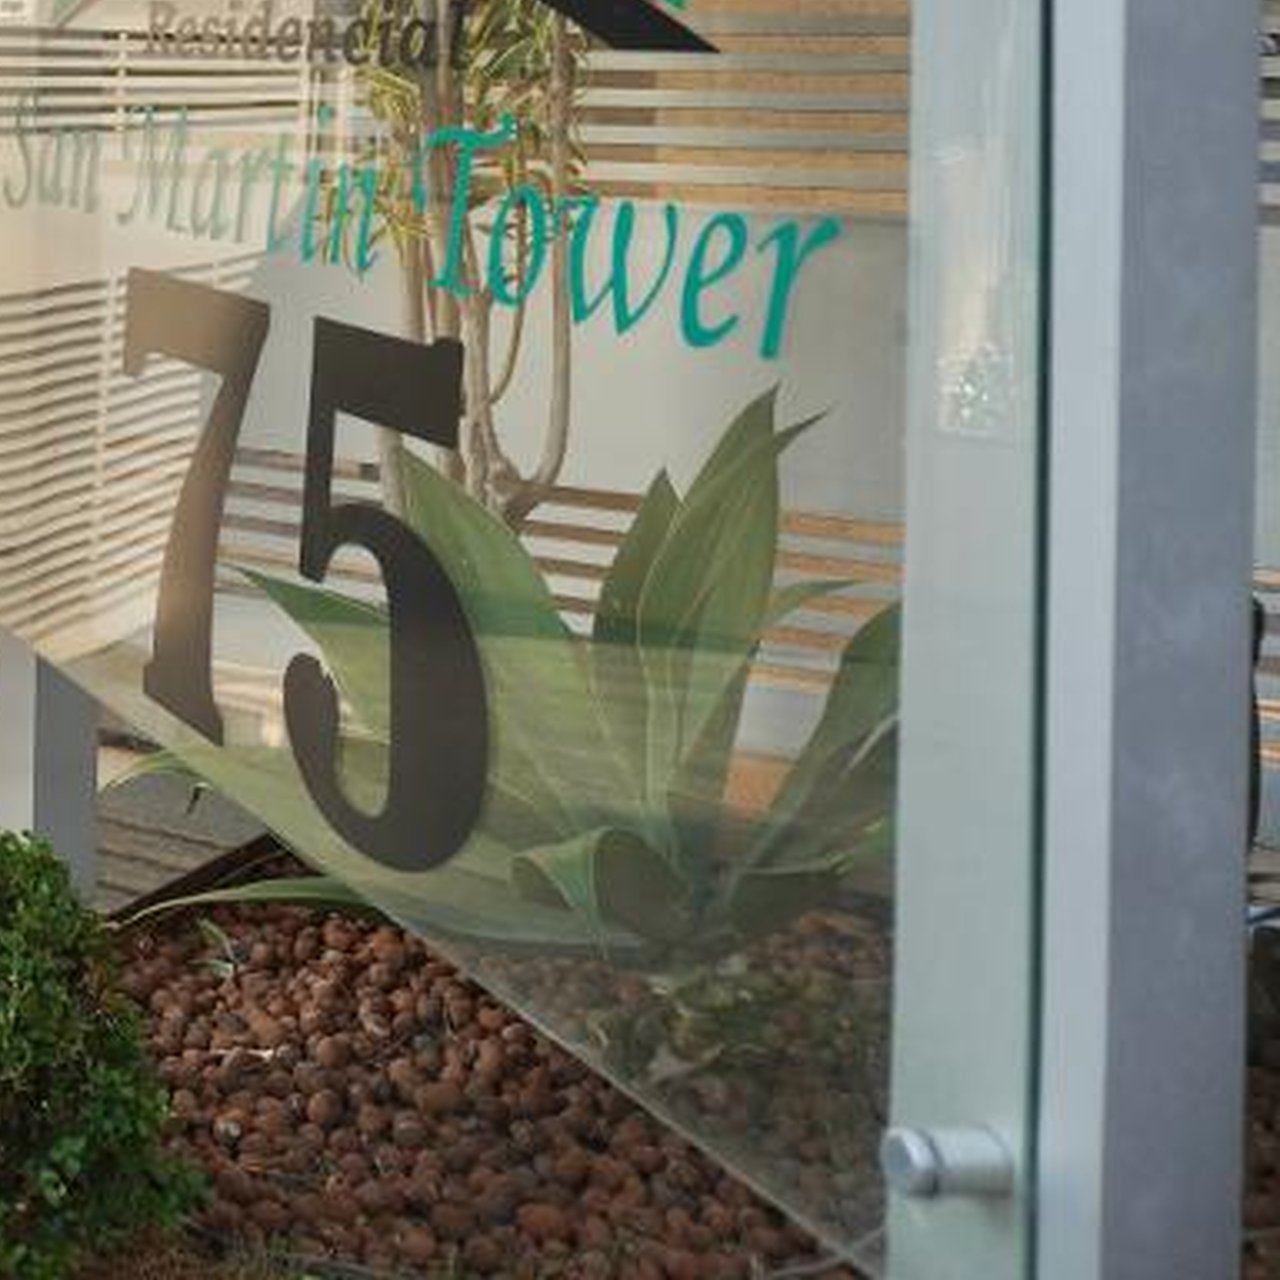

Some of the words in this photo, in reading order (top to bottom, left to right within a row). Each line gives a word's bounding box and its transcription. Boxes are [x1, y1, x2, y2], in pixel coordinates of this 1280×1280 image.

[3, 88, 100, 212] San
[116, 105, 380, 275] Martin
[411, 112, 843, 360] Tower
[124, 266, 488, 872] 75
